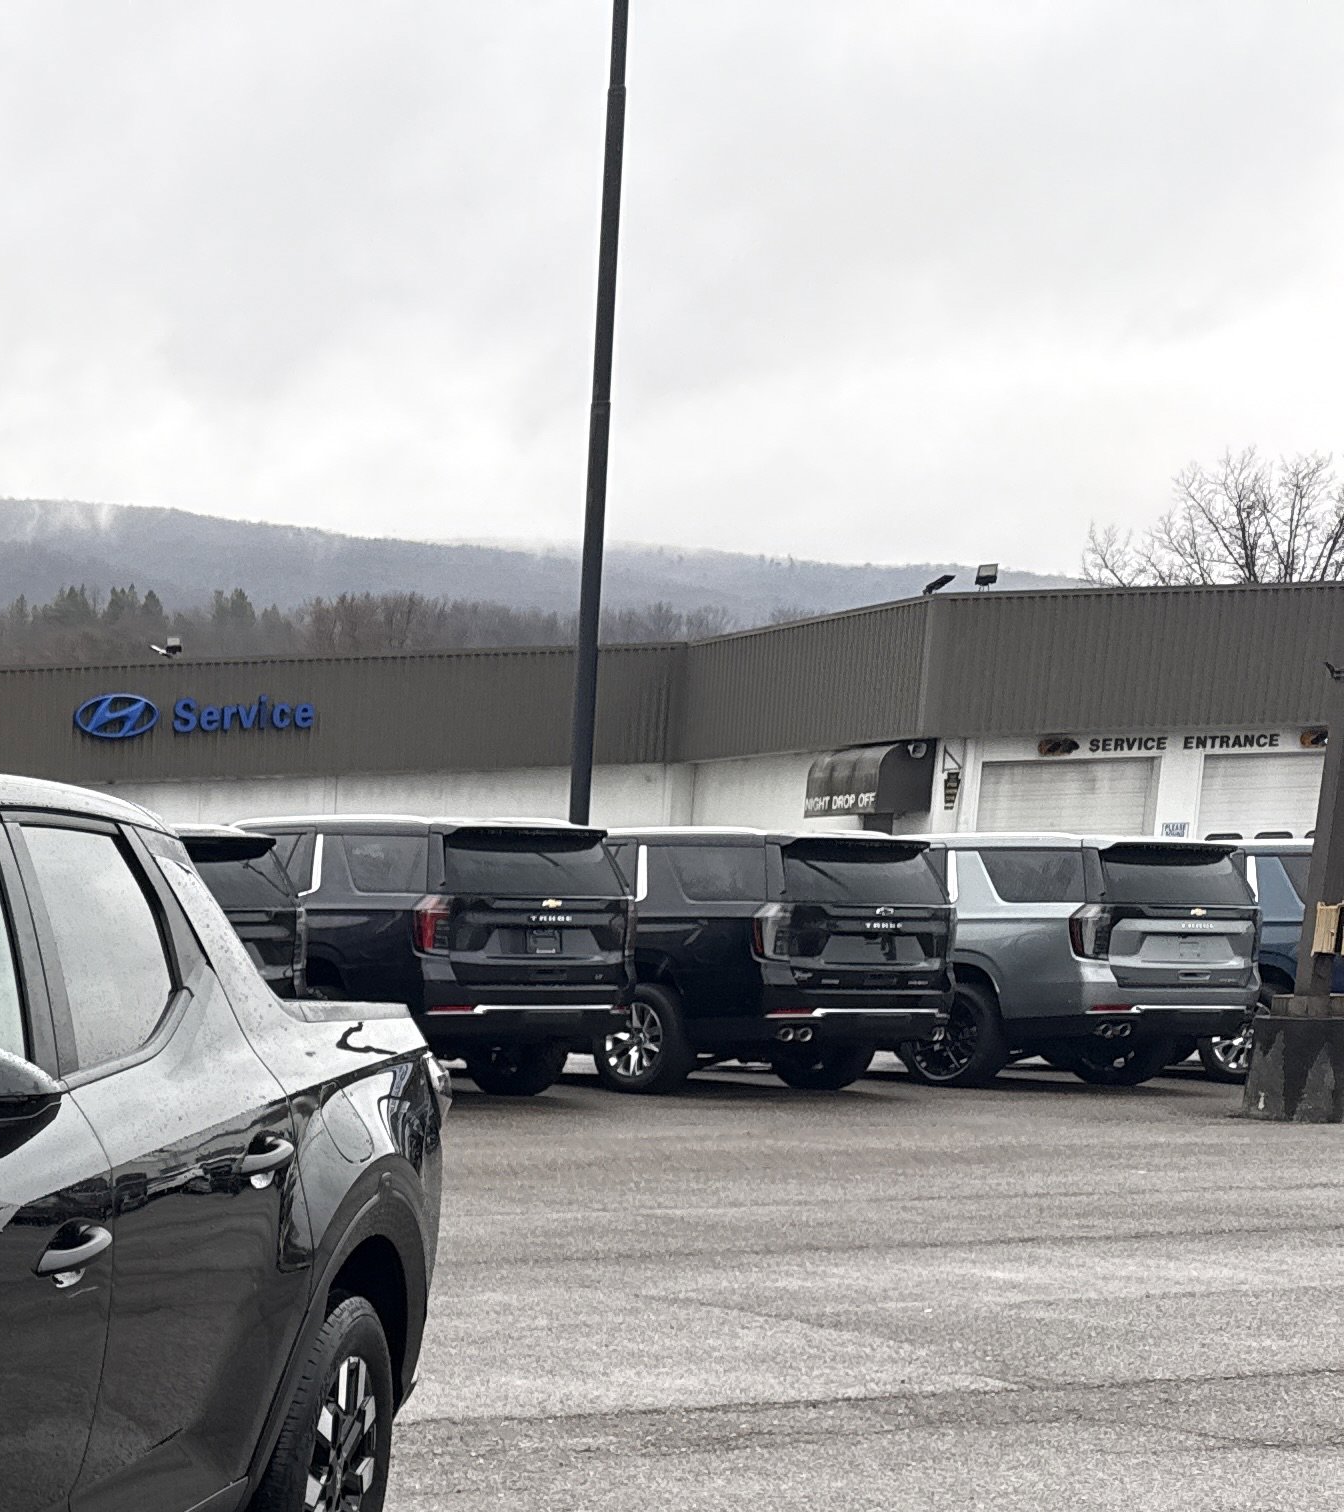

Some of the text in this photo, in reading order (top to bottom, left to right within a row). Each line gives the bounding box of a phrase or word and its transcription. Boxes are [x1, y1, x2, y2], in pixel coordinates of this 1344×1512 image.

[172, 694, 314, 733] Service
[1089, 733, 1280, 753] SERVICE ENTRANCE
[804, 791, 876, 811] NIGHT DROP OFF
